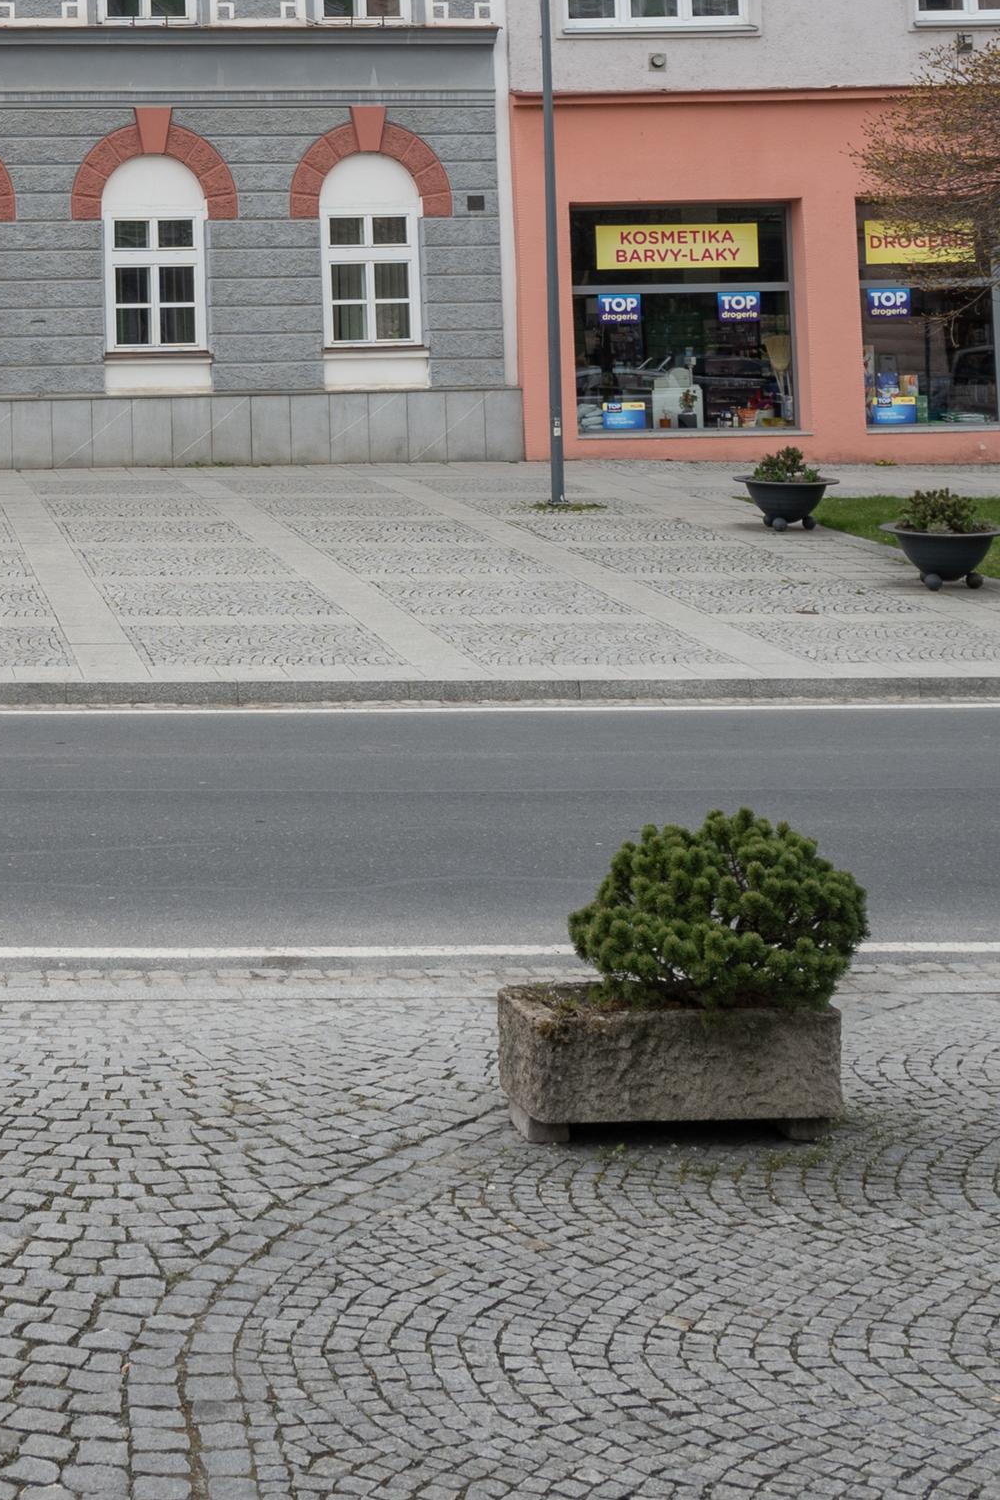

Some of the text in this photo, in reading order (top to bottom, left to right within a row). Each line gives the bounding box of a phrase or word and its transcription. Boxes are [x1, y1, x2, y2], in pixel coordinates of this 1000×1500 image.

[619, 230, 735, 245] KOSMETIKA
[615, 248, 741, 263] BARVY-LAKY
[601, 297, 638, 312] TOP
[721, 295, 757, 310] TOP
[870, 291, 908, 307] TOP
[602, 312, 638, 322] drogerie
[721, 310, 758, 320] drogerie
[871, 307, 908, 317] drogerie
